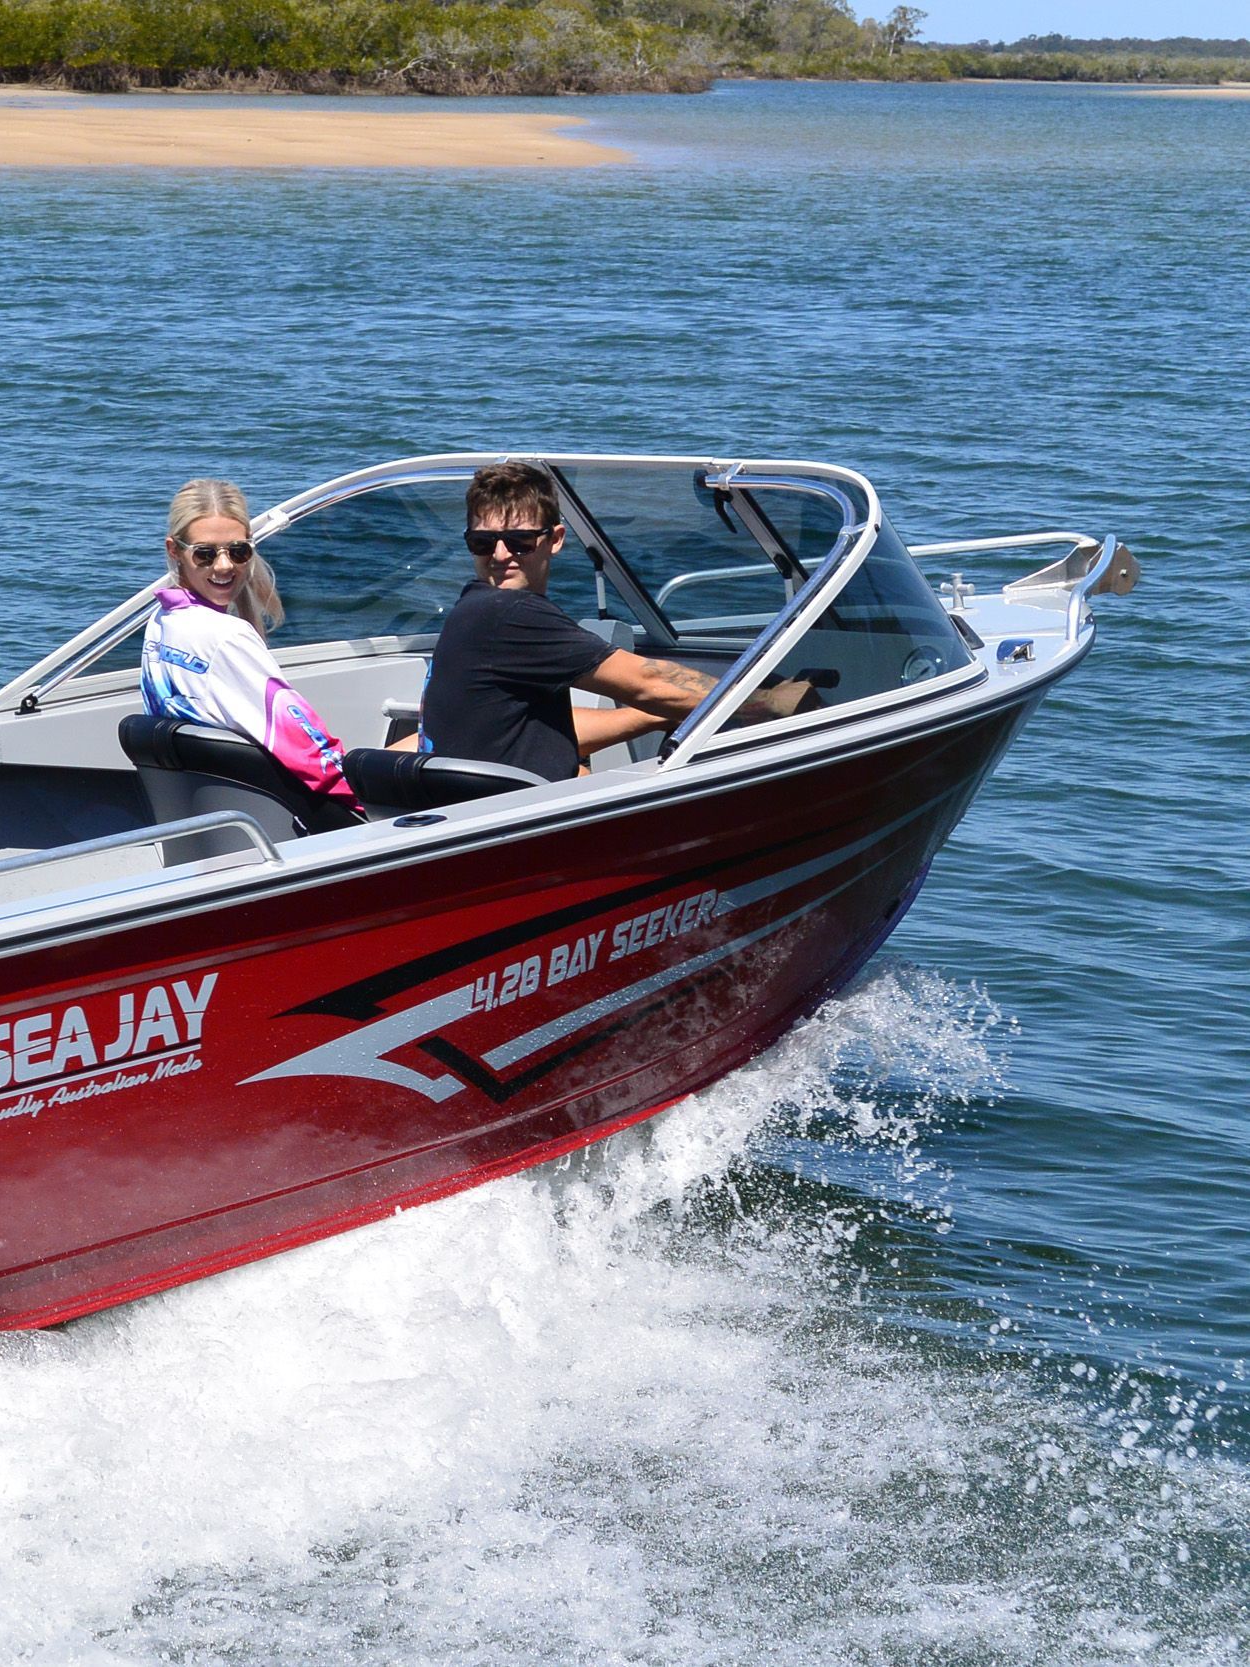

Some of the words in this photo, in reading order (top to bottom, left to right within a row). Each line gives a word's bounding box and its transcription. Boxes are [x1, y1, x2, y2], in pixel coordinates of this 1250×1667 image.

[469, 955, 542, 1012] 4.28
[546, 929, 606, 987] BAY
[608, 888, 718, 963] SEEKER
[104, 972, 219, 1061] JAY
[48, 1071, 150, 1107] Australian
[150, 1053, 203, 1082] Made
